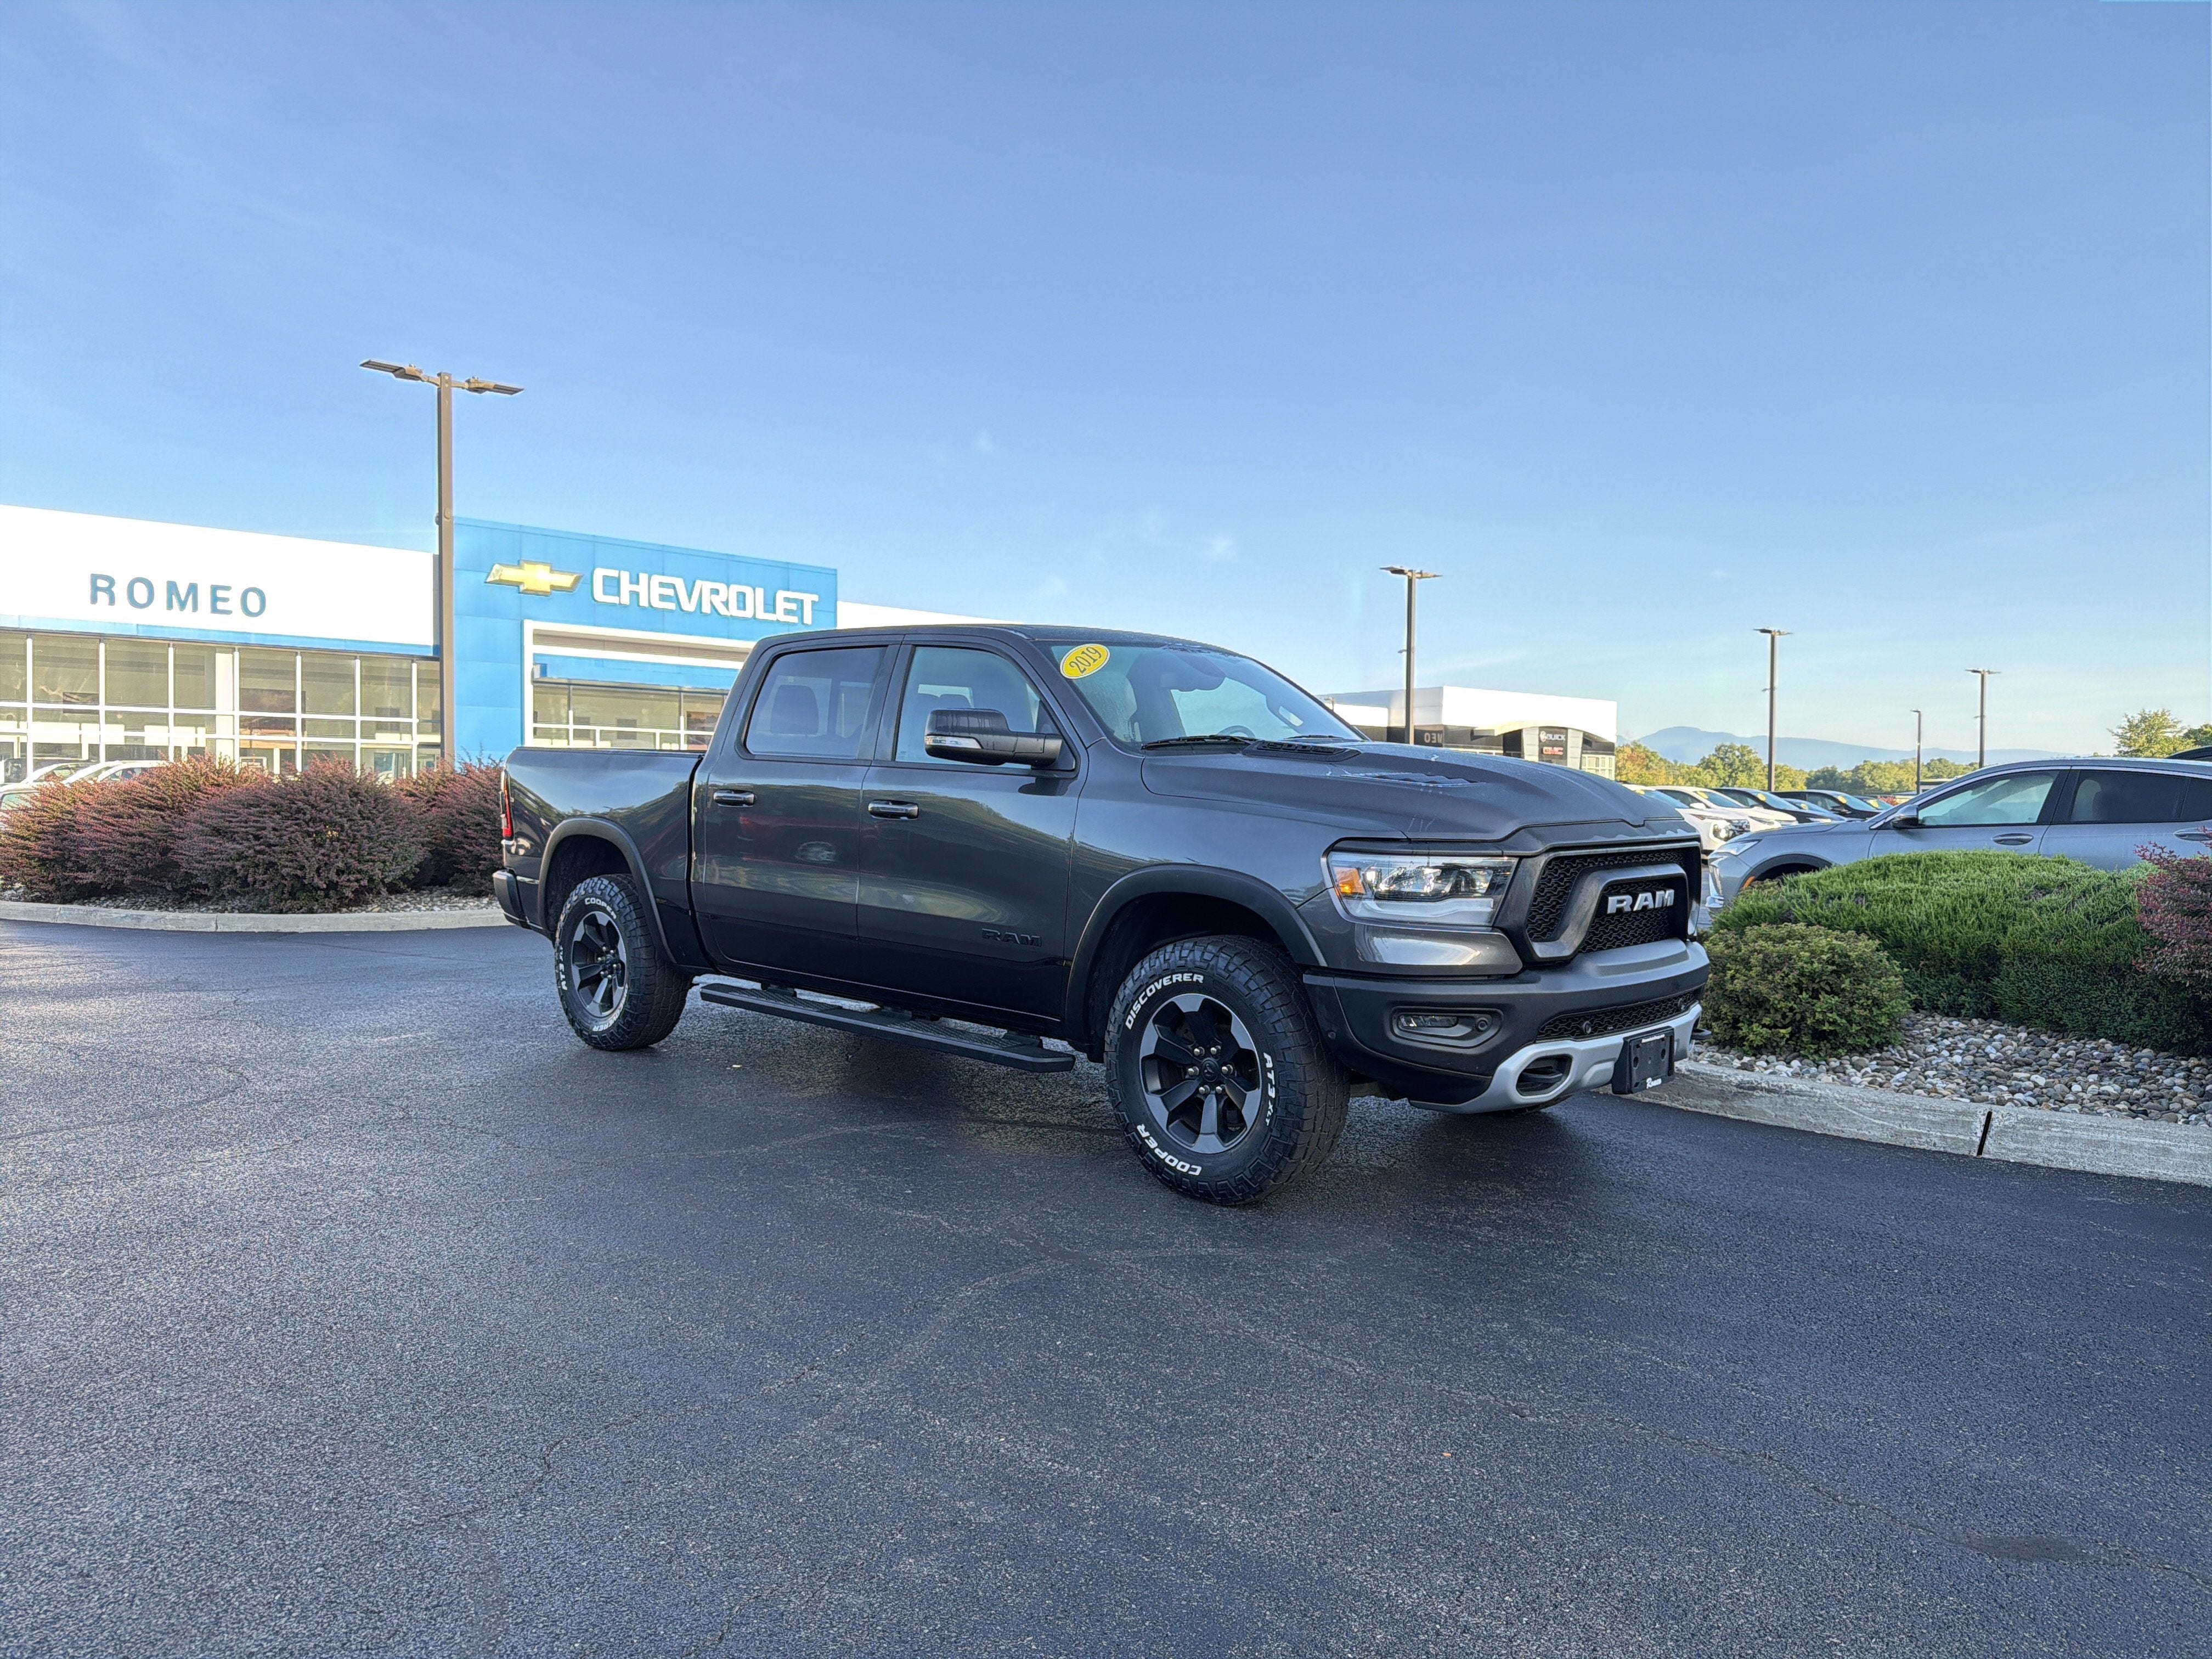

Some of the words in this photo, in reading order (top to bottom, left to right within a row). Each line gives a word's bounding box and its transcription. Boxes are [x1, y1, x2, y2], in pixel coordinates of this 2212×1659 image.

[89, 573, 266, 618] ROMEO
[593, 567, 819, 625] CHEVROLET
[1069, 646, 1102, 674] 2019
[584, 897, 617, 919] COOPER
[1607, 889, 1675, 915] RAM
[981, 928, 1042, 947] RAM
[1125, 973, 1204, 1030] DISCOVERER
[1263, 1052, 1276, 1098] AT3
[1136, 1123, 1203, 1176] COOPER
